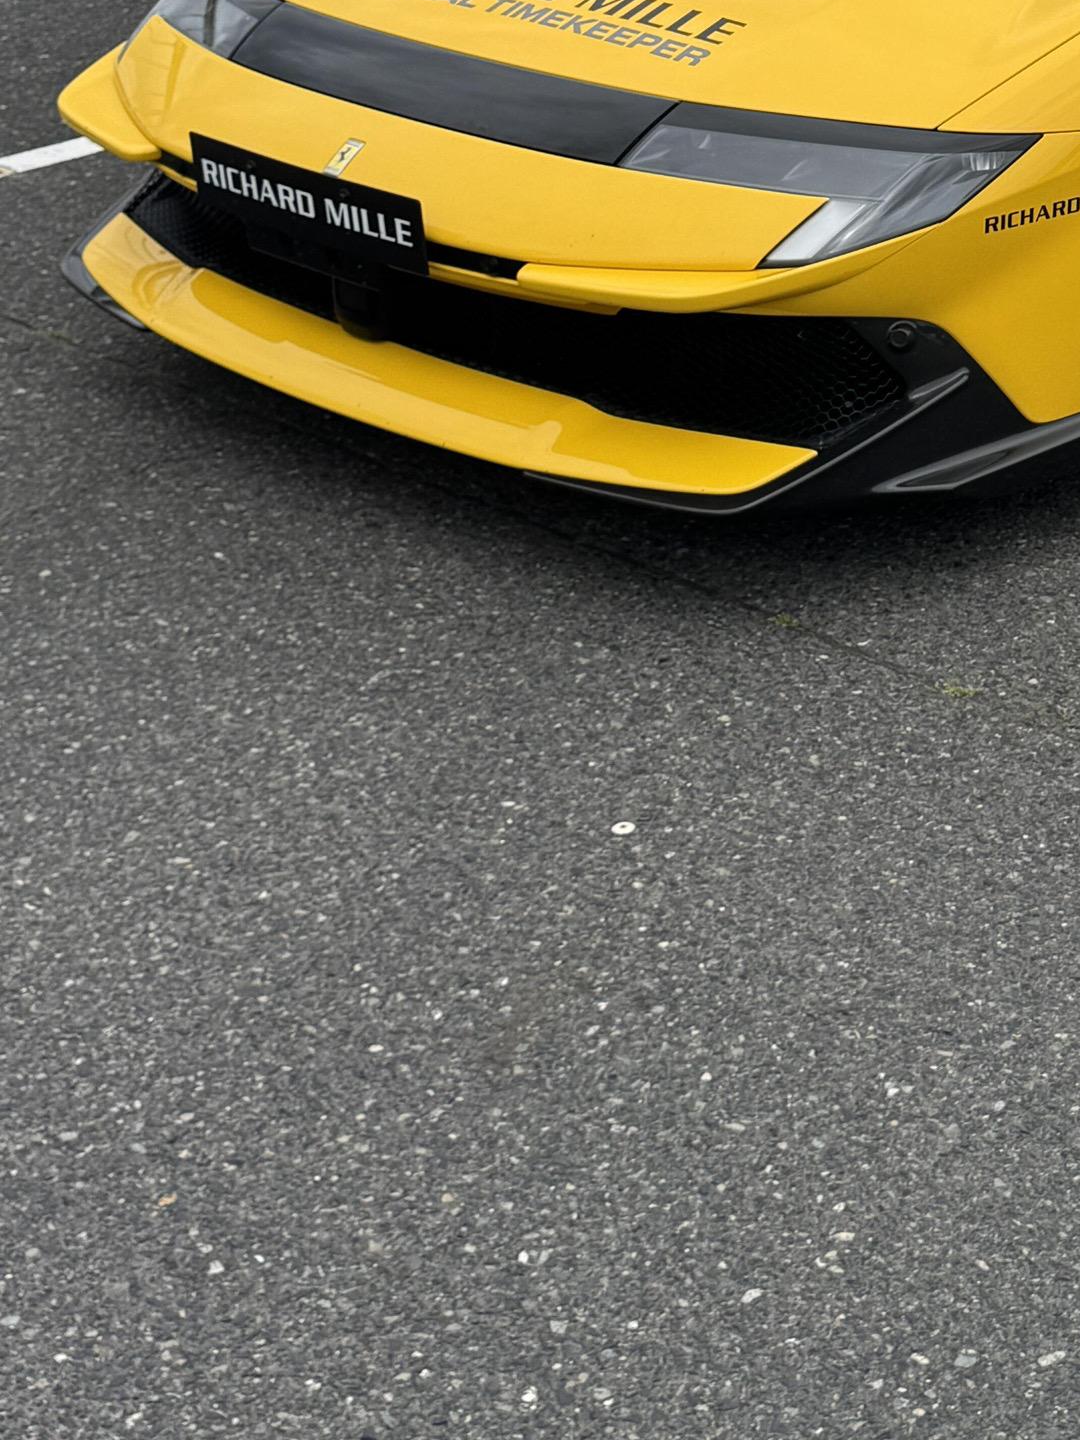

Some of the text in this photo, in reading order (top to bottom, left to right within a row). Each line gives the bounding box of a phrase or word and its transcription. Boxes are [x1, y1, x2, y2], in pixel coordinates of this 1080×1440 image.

[200, 158, 414, 248] RICHARD MILLE
[984, 197, 1080, 234] RICHARD
